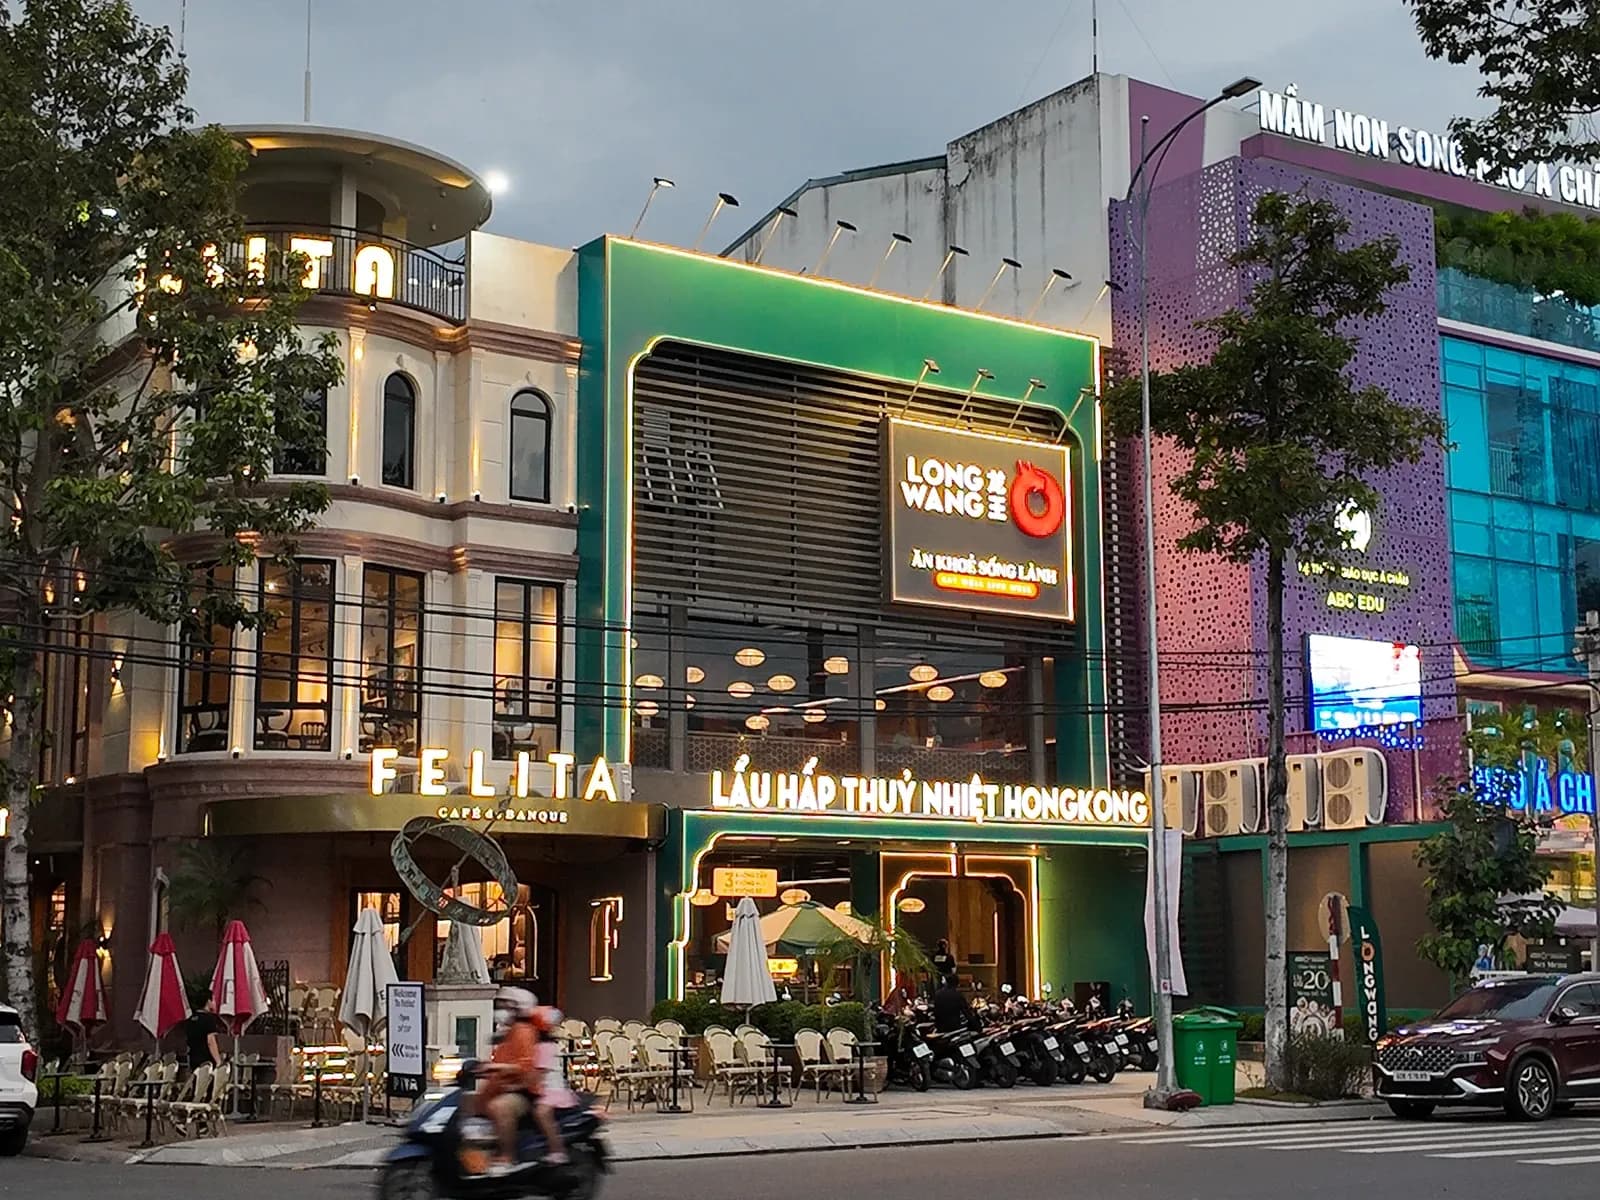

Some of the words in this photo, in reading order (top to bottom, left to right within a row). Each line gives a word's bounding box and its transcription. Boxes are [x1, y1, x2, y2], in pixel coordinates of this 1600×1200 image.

[1259, 82, 1325, 142] MẦM
[1334, 108, 1388, 159] NON
[906, 455, 984, 492] LONG
[900, 481, 985, 519] WANG
[911, 548, 934, 569] ĂN
[978, 556, 1017, 580] SỐNG
[1018, 562, 1058, 585] LÀNH
[1387, 571, 1410, 586] CHÂU
[1326, 591, 1354, 609] ABC
[1357, 594, 1385, 613] EDU
[371, 747, 618, 802] FELITA
[777, 756, 837, 811] HẤP
[841, 767, 917, 815] THUỶ
[922, 772, 999, 825] NHIỆT
[1003, 784, 1148, 824] HONGKONG
[437, 806, 481, 819] CAFÉ
[505, 808, 568, 824] BANQUE
